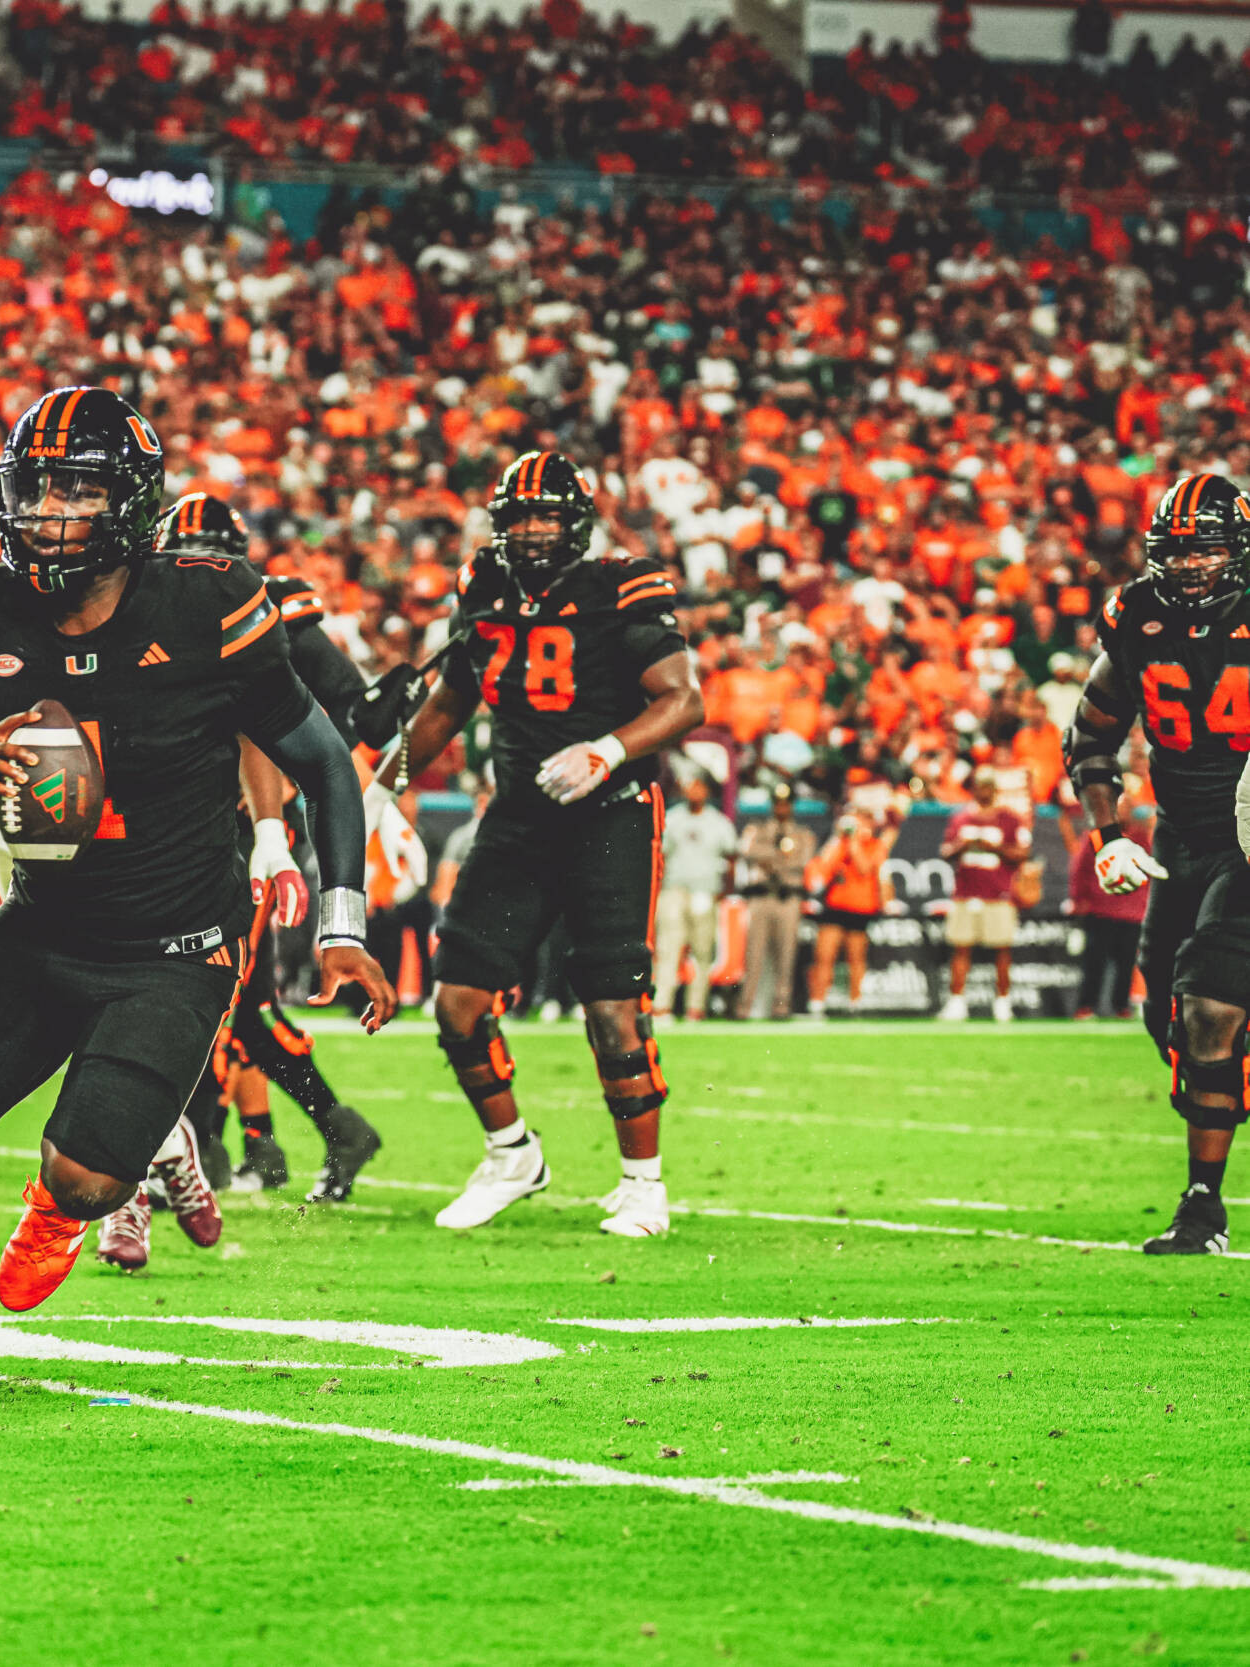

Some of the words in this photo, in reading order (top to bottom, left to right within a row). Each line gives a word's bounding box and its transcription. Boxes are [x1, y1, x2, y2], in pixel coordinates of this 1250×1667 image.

[28, 446, 66, 458] MIAMI
[65, 653, 98, 675] U
[475, 620, 577, 712] 78
[1141, 661, 1250, 753] 64
